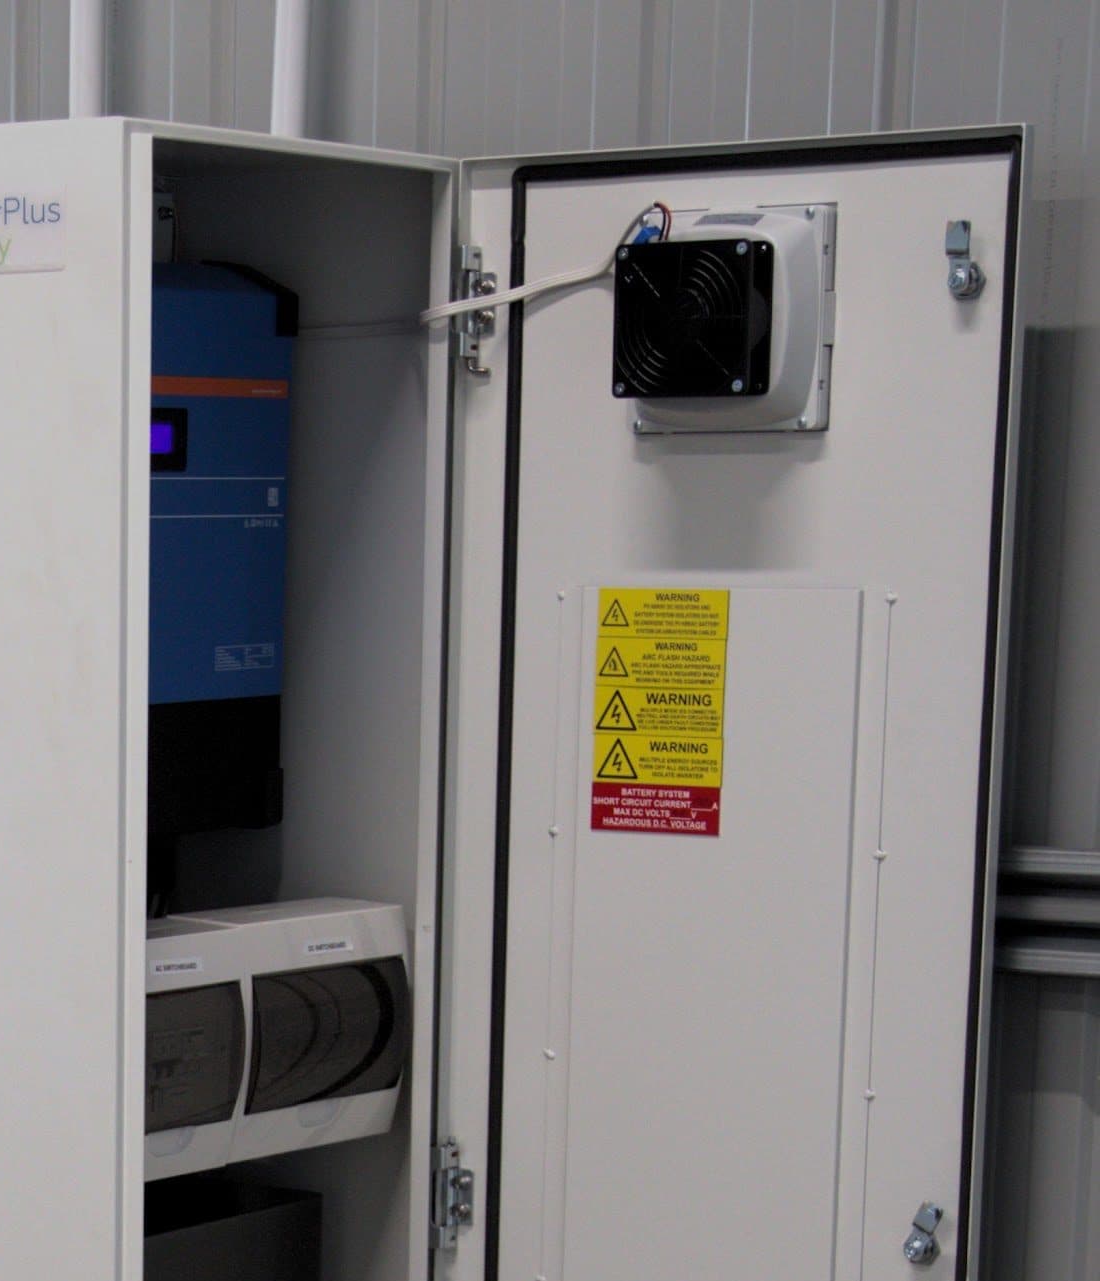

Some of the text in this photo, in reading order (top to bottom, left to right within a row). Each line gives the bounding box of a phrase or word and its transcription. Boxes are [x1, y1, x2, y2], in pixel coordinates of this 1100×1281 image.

[655, 593, 700, 602] WARNING
[654, 642, 698, 651] WARNING
[646, 692, 712, 706] WARNING
[650, 741, 708, 754] WARNING
[621, 788, 690, 798] BATTERY SYSTEM
[593, 797, 620, 805] SHORT
[621, 798, 652, 807] CIRCUIT
[613, 807, 630, 816] MAX
[632, 808, 643, 816] DC
[602, 816, 707, 830] HAZARDOUS D.C. VOLTAGE
